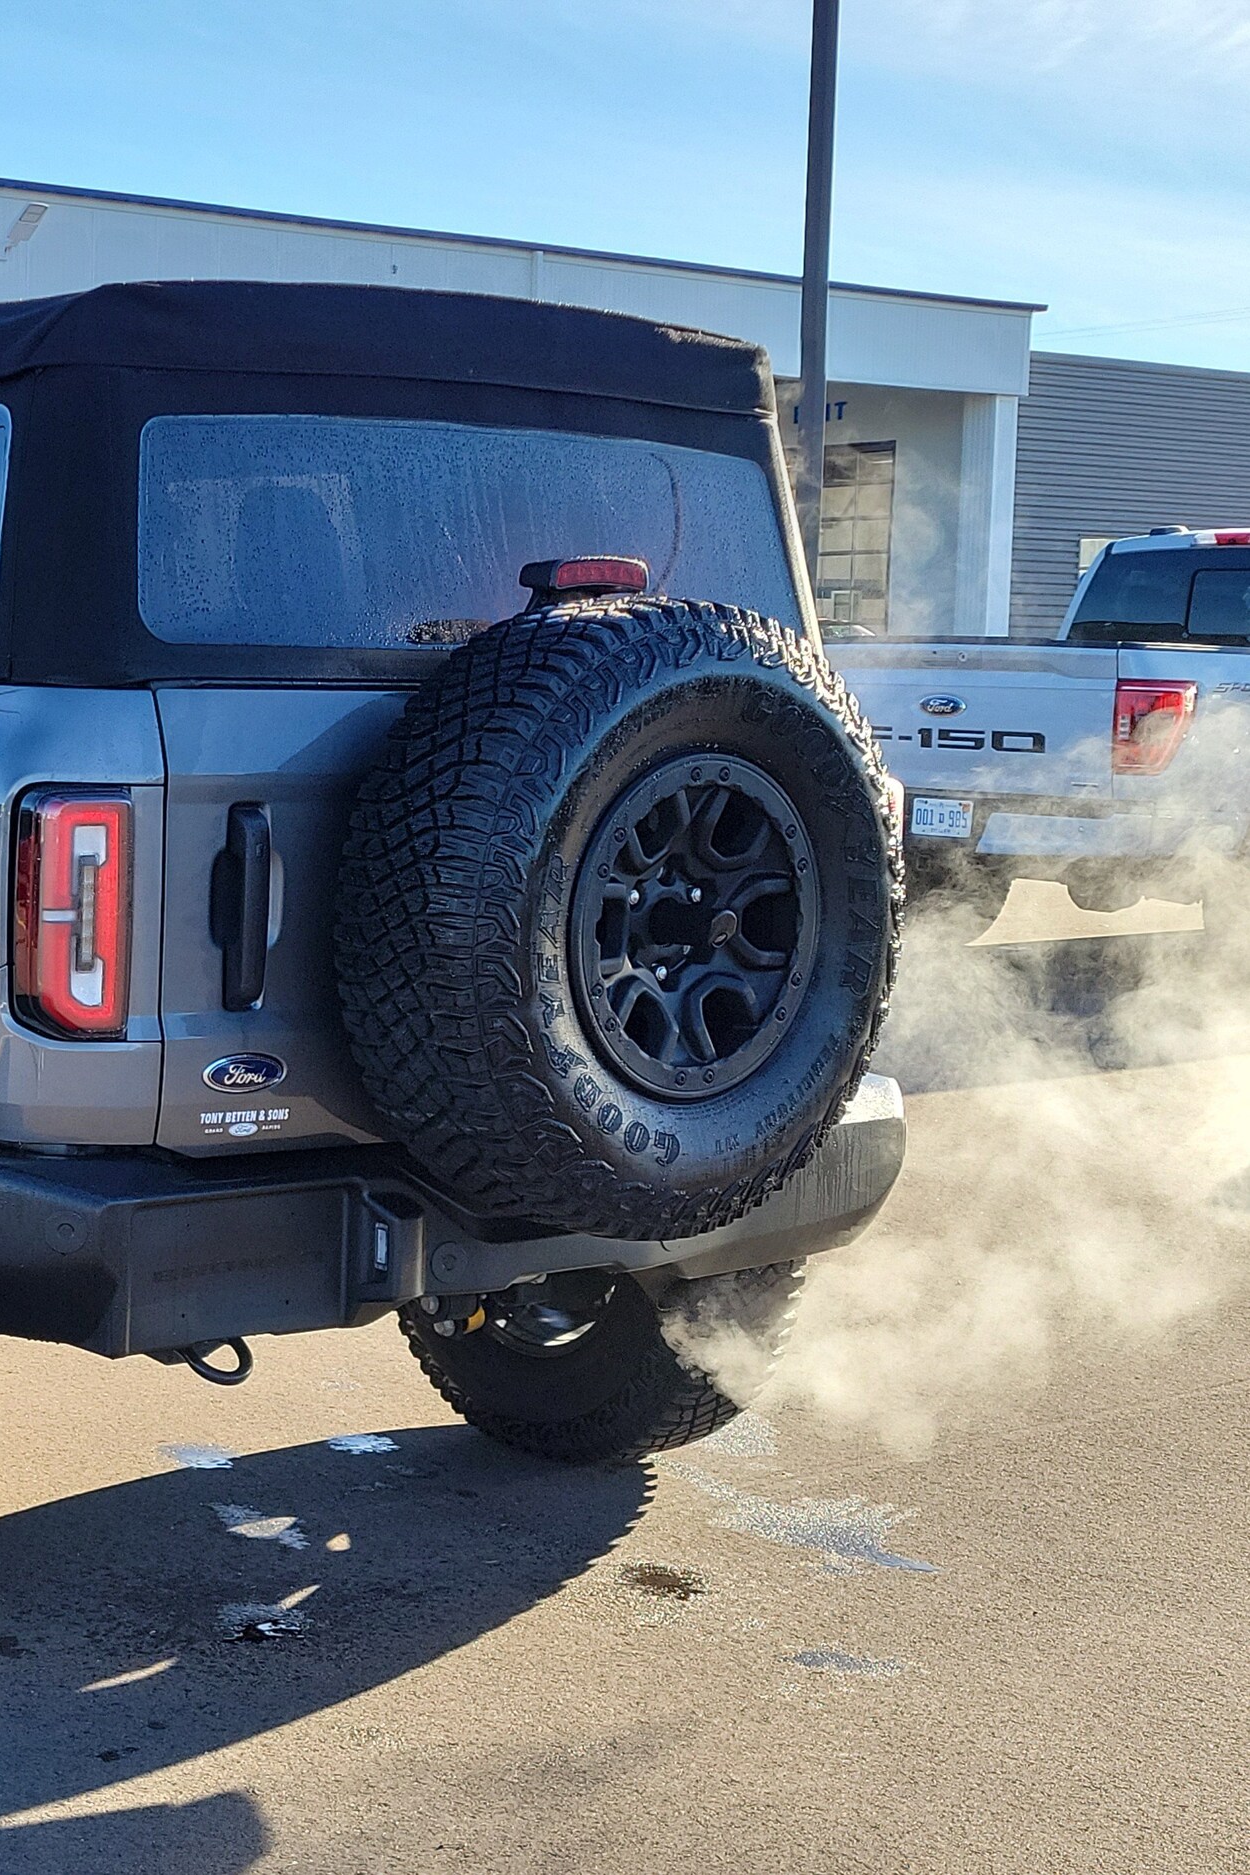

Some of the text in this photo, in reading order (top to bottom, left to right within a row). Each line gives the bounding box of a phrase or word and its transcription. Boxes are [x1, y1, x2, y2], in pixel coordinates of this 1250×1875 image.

[793, 401, 848, 424] IT
[915, 808, 934, 826] 001
[224, 1063, 267, 1085] Ford
[200, 1108, 290, 1124] TONY BETTEN & SONS
